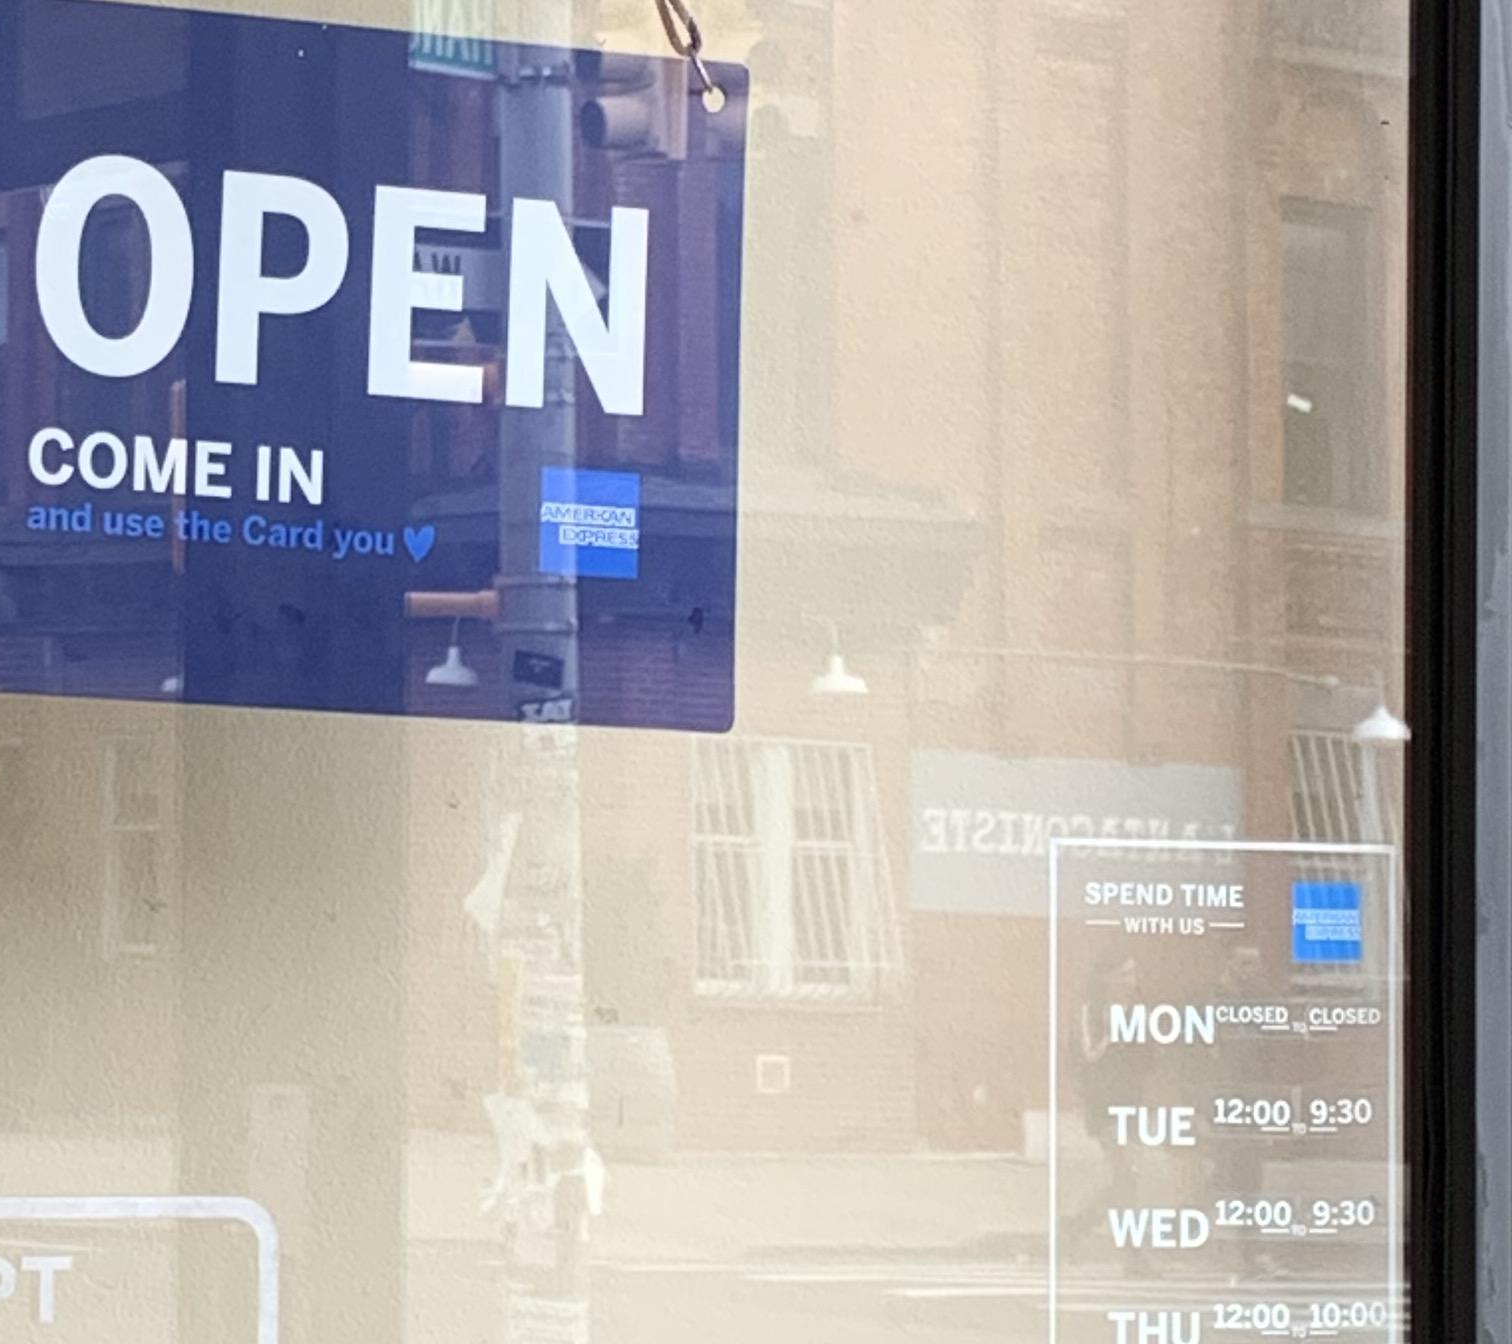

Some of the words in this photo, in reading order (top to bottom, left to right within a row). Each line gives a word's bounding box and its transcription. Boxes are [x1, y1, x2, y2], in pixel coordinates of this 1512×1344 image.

[36, 154, 649, 416] OPEN
[28, 428, 232, 499] COME
[255, 448, 324, 505] IN
[27, 504, 92, 533] and
[103, 513, 164, 539] use
[177, 512, 232, 543] the
[242, 518, 322, 552] Card
[334, 529, 394, 559] you
[541, 506, 635, 526] AMERICAN
[560, 527, 639, 548] EXPRESS
[1085, 882, 1174, 906] SPEND
[1180, 884, 1245, 908] TIME
[1124, 917, 1174, 934] WITH
[1179, 918, 1205, 935] US
[1109, 1005, 1216, 1044] MON
[1216, 1006, 1288, 1025] CLOSED
[1309, 1008, 1381, 1027] CLOSED
[1108, 1106, 1196, 1146] TUE
[1213, 1099, 1290, 1125] 12:00
[1309, 1099, 1372, 1125] 9:30
[1108, 1208, 1210, 1248] WED
[1215, 1201, 1291, 1226] 12:00
[1312, 1201, 1375, 1226] 9:30
[1213, 1304, 1290, 1329] 12:00
[1310, 1303, 1386, 1328] 10:00
